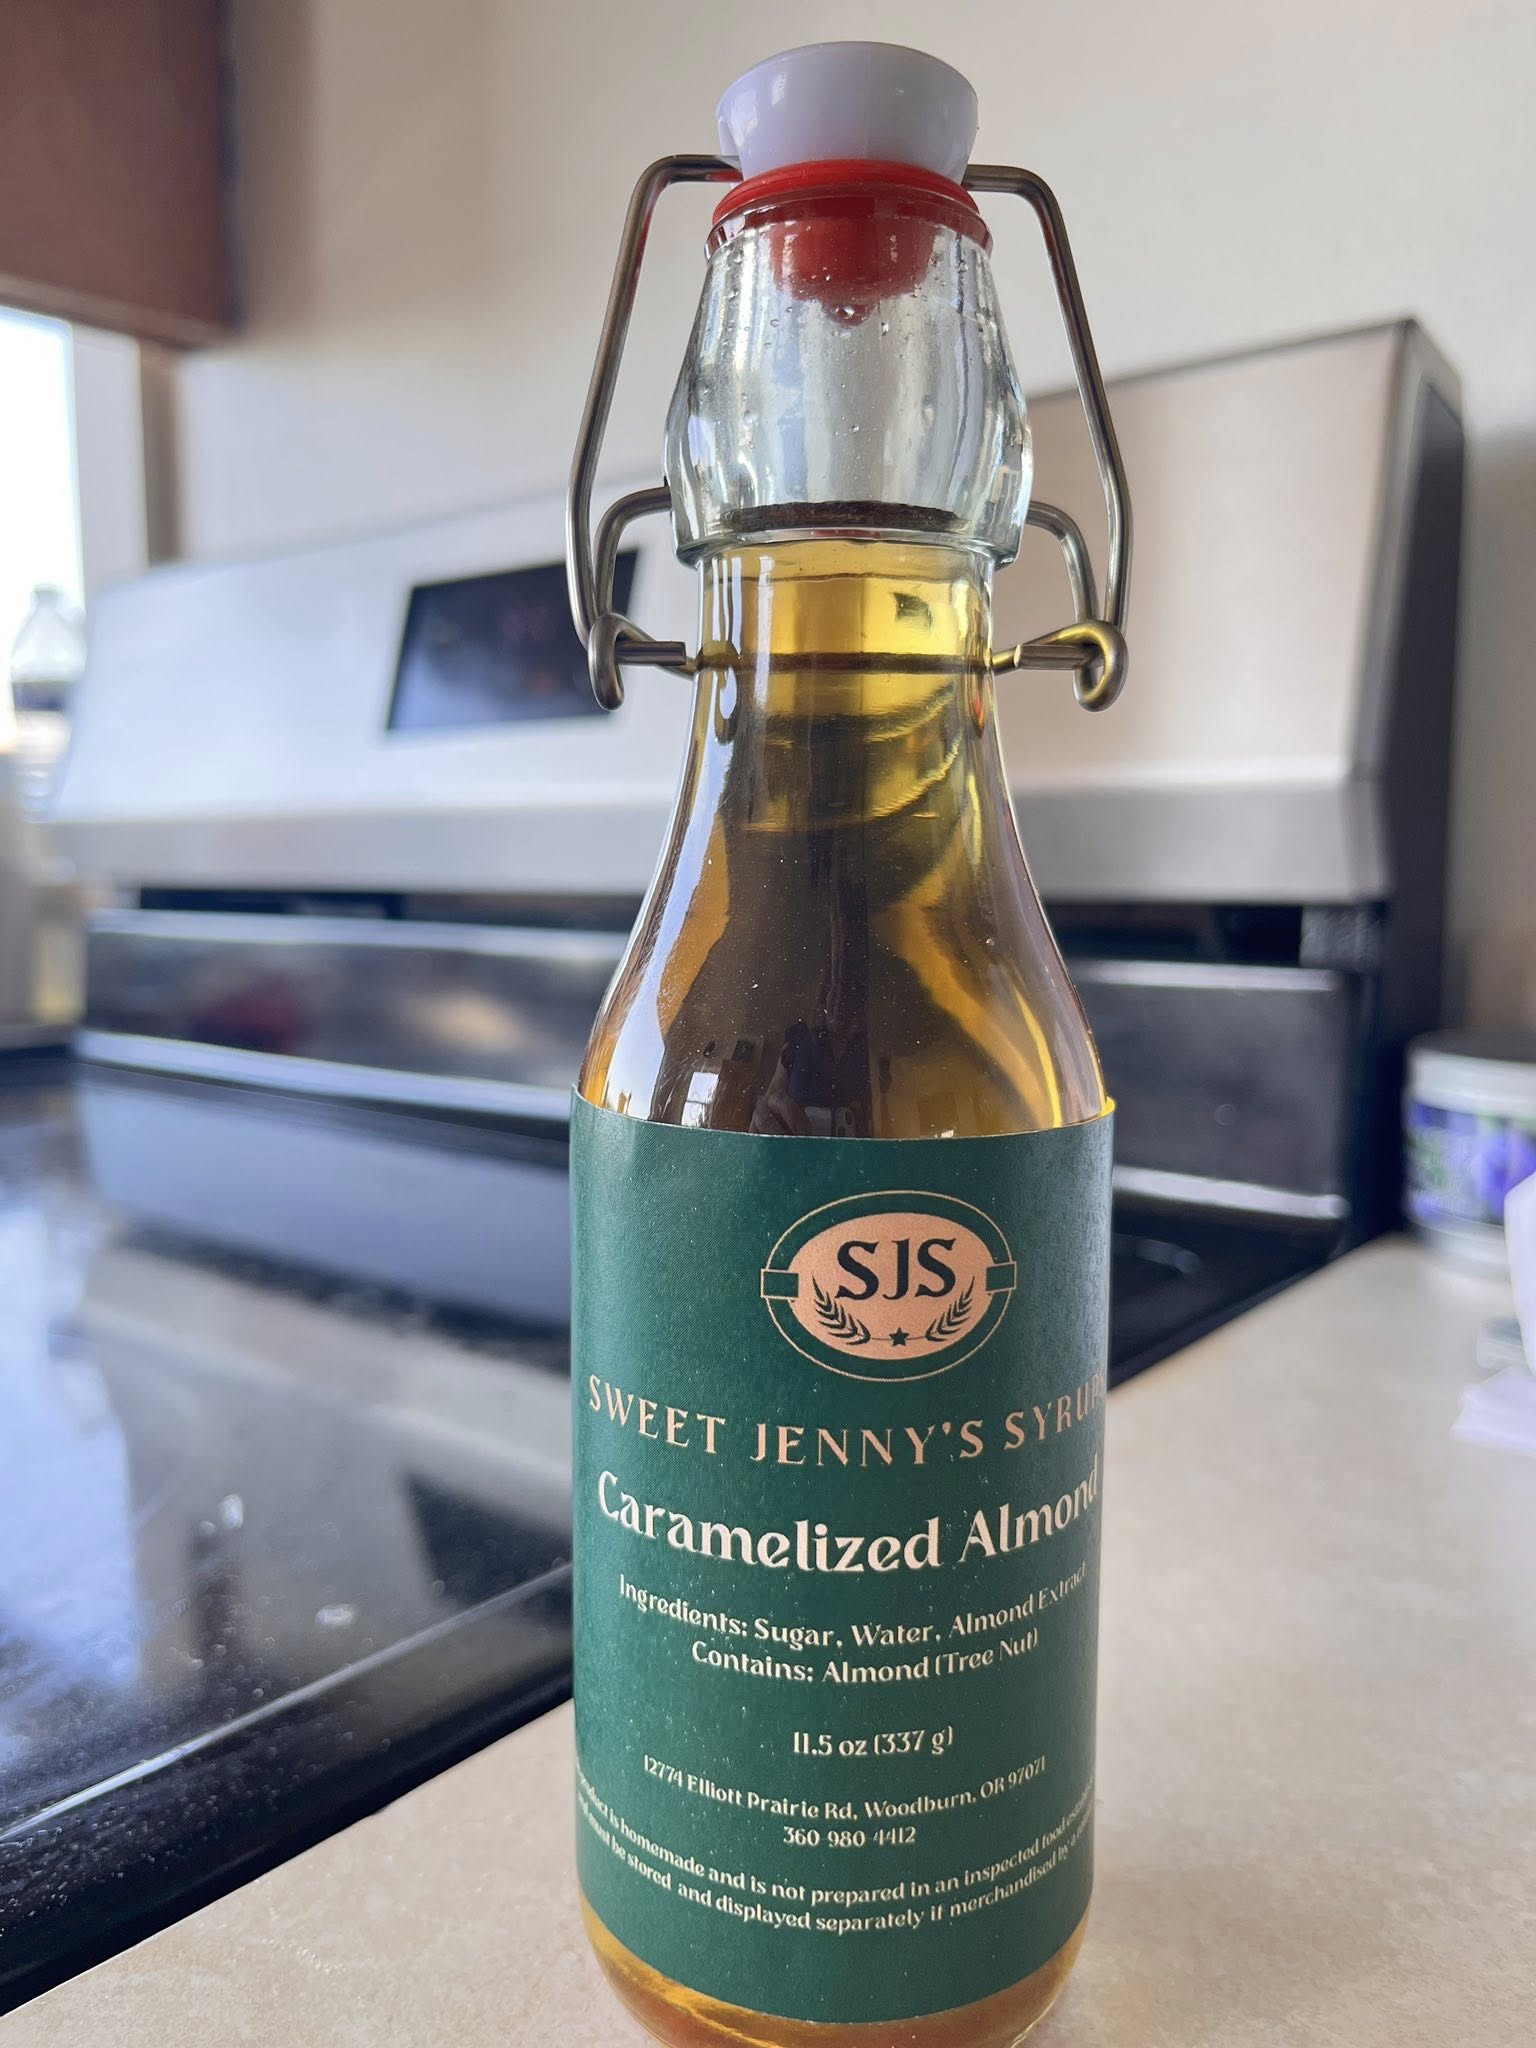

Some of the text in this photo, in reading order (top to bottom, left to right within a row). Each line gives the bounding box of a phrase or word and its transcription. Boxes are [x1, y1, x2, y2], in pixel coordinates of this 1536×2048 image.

[834, 1238, 957, 1301] SJS
[589, 1374, 726, 1454] SWEET
[750, 1419, 983, 1466] JENNY'S
[597, 1452, 1098, 1573] Caramelized Almond
[619, 1573, 748, 1637] Ingredients:
[754, 1617, 843, 1651] Sugar,
[950, 1592, 1034, 1638] Almond
[1037, 1561, 1087, 1610] Extract
[691, 1627, 1039, 1684] Contains: Almond (Tree Nut)
[793, 1725, 953, 1757] 11.5 oz (337 g)
[643, 1754, 683, 1787] 12774
[687, 1773, 743, 1806] Elliott
[747, 1790, 819, 1818] Prairie
[980, 1776, 1005, 1799] OR
[1008, 1754, 1046, 1788] 97071
[609, 1807, 619, 1829] is
[620, 1817, 705, 1877] homemade
[708, 1867, 746, 1891] and
[750, 1874, 767, 1895] is
[771, 1883, 806, 1901] not
[811, 1880, 905, 1908] prepared
[911, 1880, 930, 1898] in
[935, 1876, 960, 1894] an
[964, 1837, 1040, 1887] inspected
[783, 1825, 917, 1848] 360 980 4412
[611, 1835, 626, 1861] be
[626, 1852, 672, 1891] stored
[677, 1882, 712, 1908] and
[715, 1894, 812, 1929] displayed
[815, 1908, 925, 1936] separately
[949, 1850, 1057, 1917] merchandised
